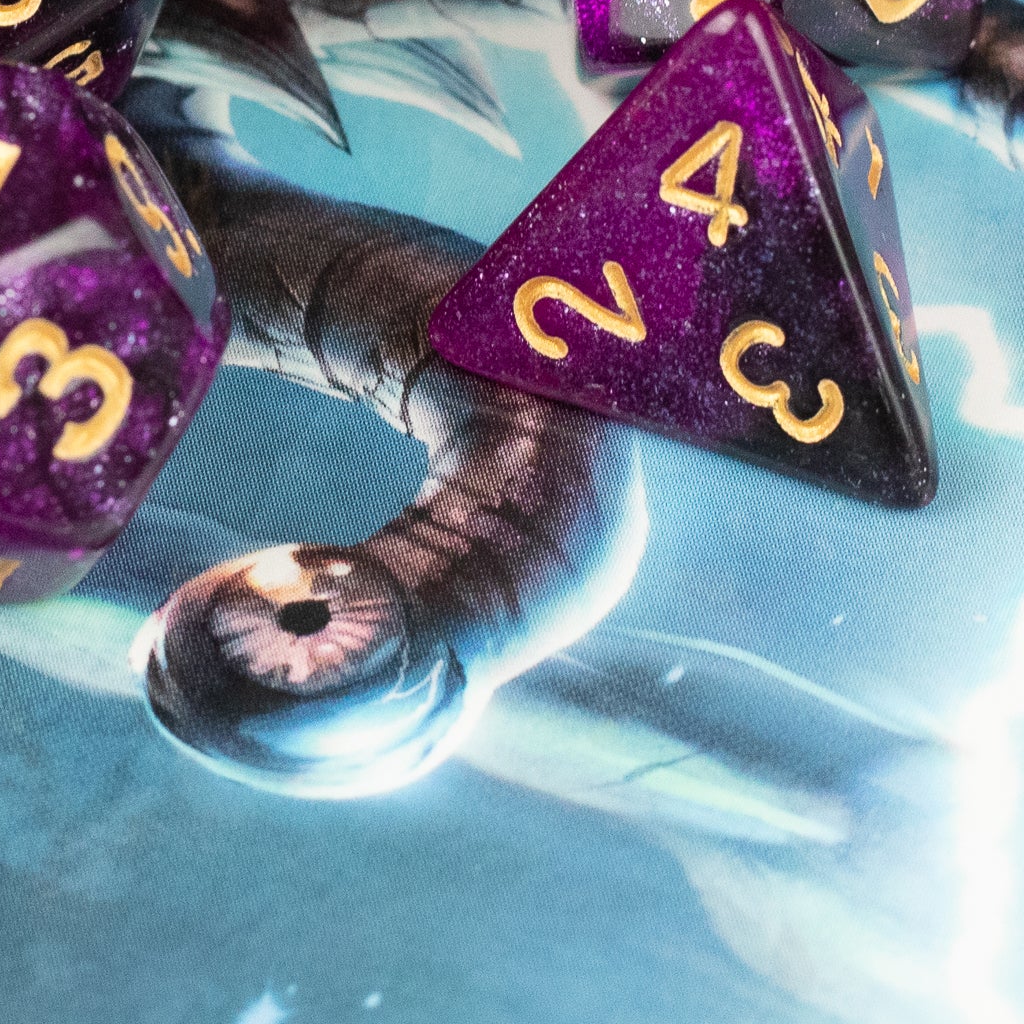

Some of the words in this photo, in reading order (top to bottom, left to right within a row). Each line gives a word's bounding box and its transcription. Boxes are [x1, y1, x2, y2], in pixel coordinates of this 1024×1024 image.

[659, 120, 748, 248] 4
[513, 260, 647, 359] 2
[719, 319, 845, 444] 3
